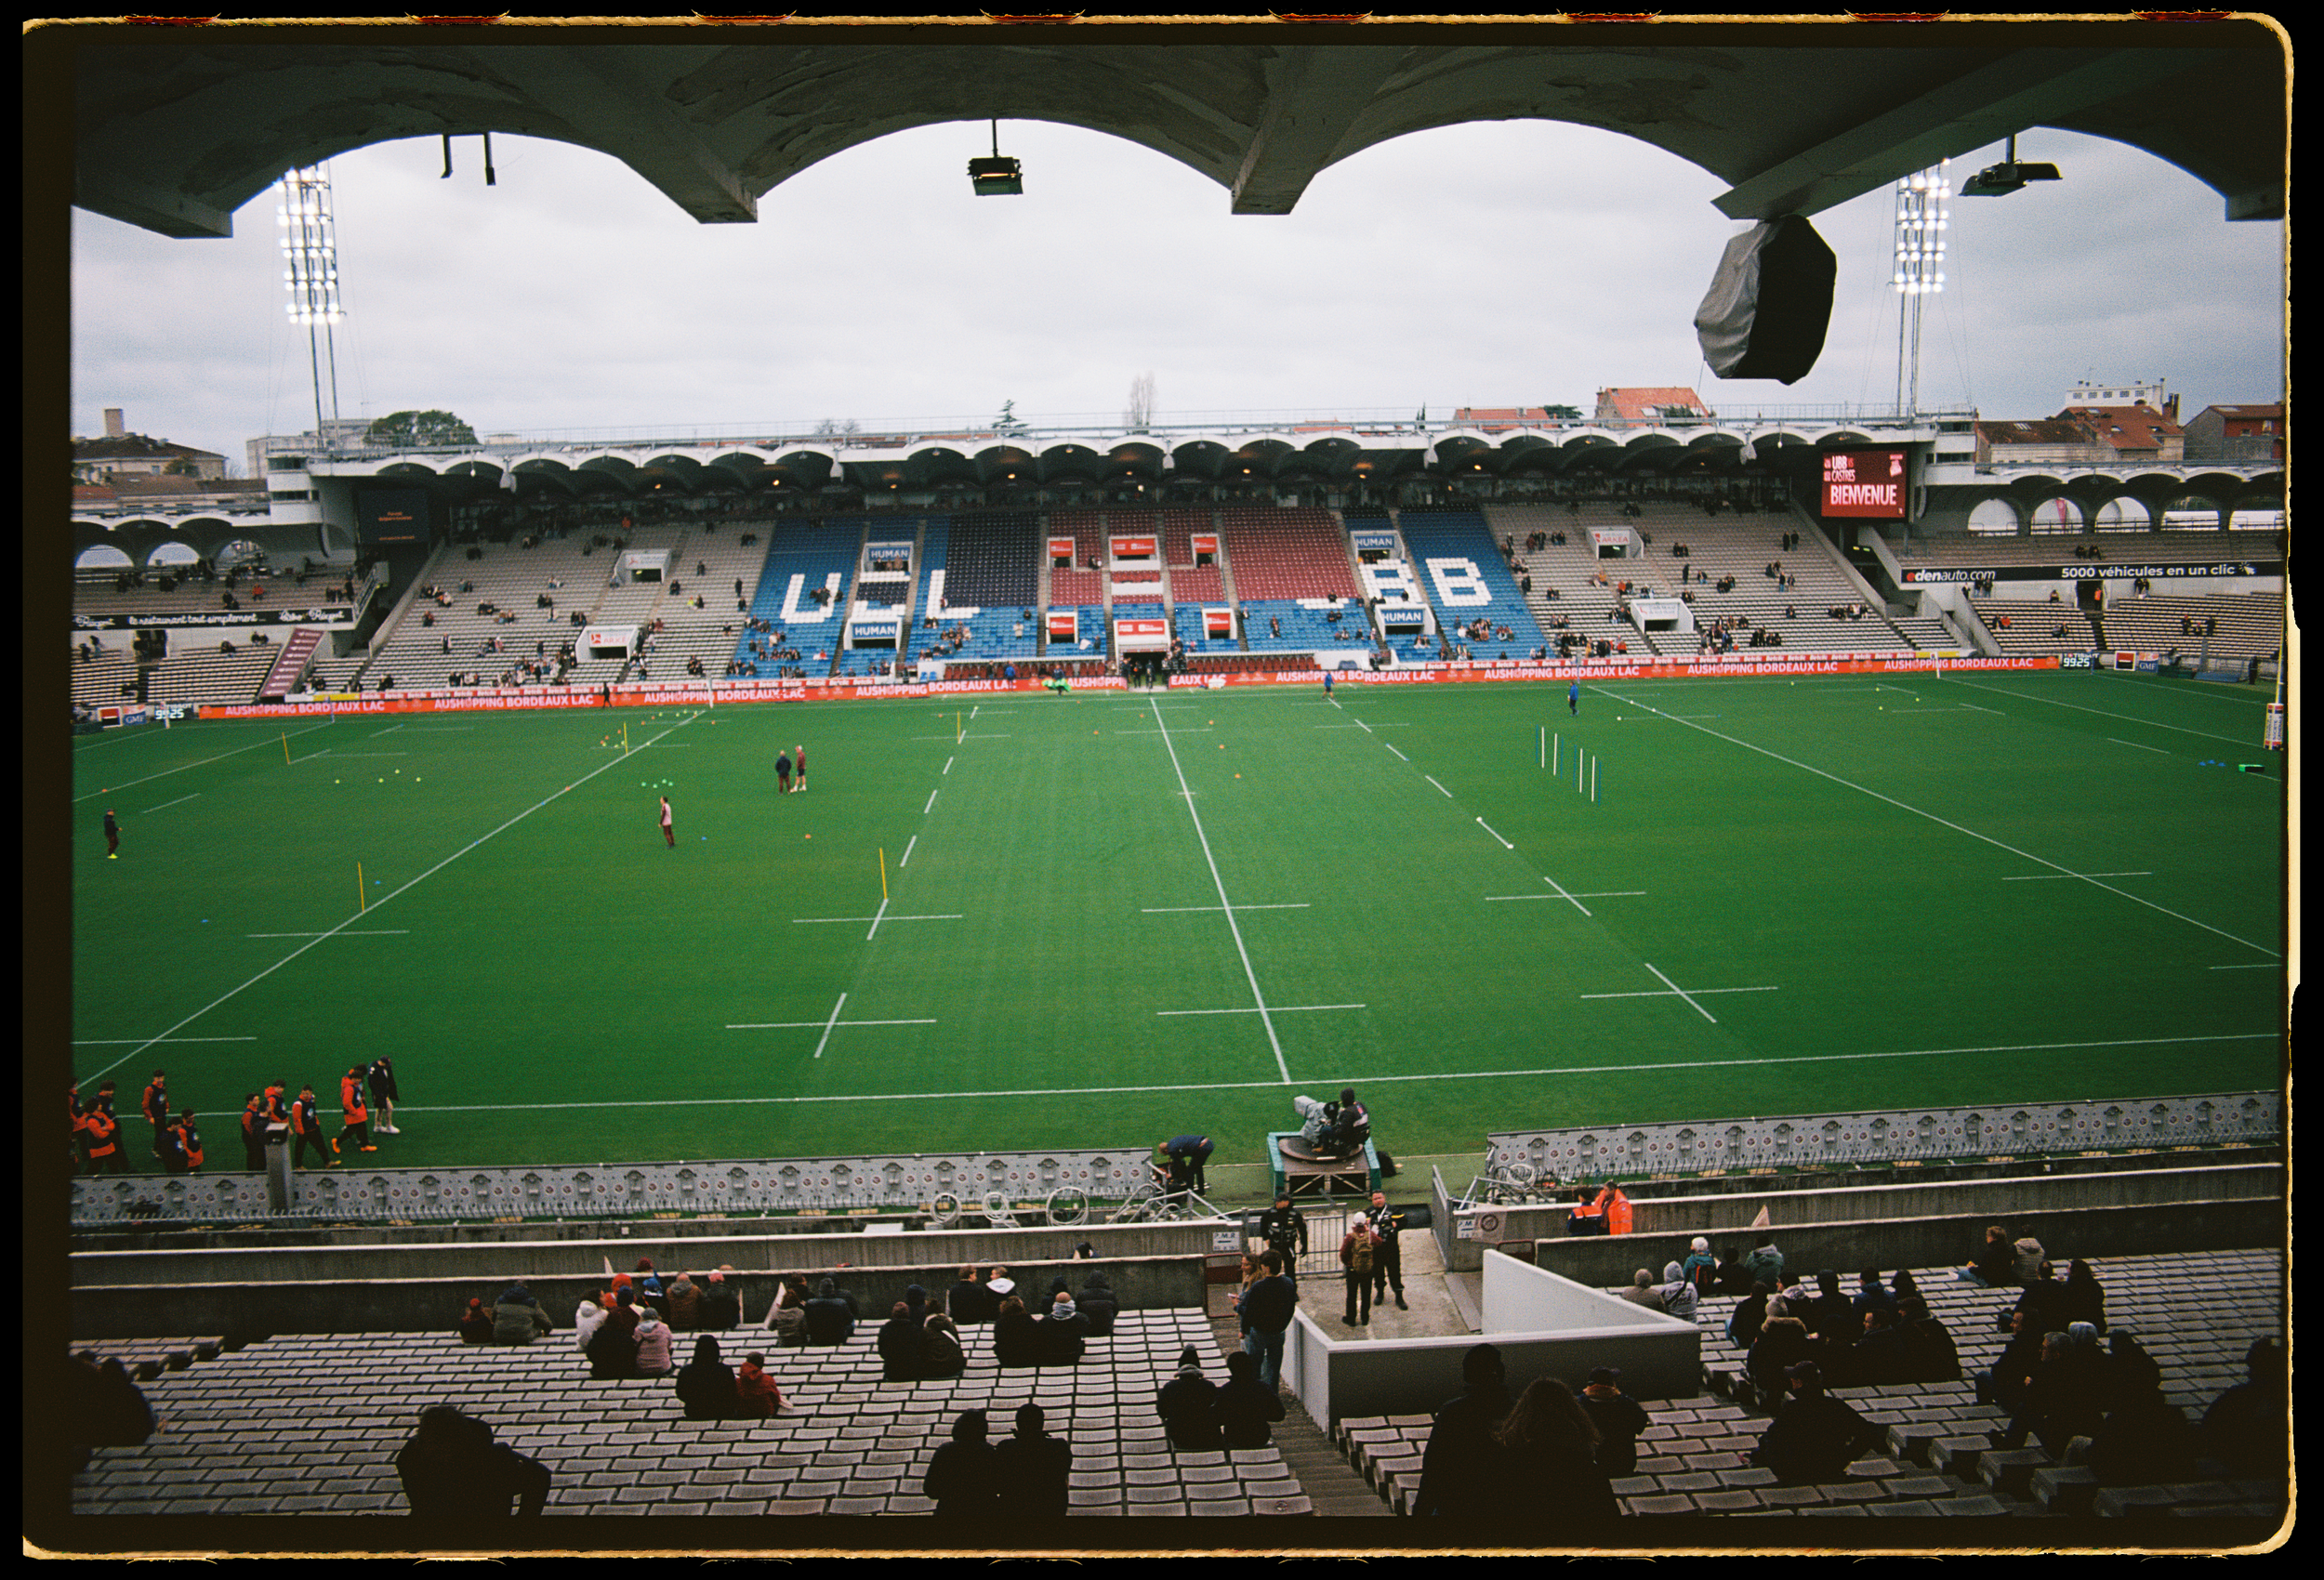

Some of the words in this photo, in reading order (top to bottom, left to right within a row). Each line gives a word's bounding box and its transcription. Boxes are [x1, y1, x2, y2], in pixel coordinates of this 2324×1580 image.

[1830, 484, 1897, 505] BIENVENUE
[1356, 538, 1393, 546] HUMAN
[871, 549, 908, 559] HUMAN
[1907, 569, 1996, 582] edenauto.com
[2061, 567, 2095, 578] 5000
[2098, 566, 2163, 577] véhicules
[2167, 568, 2185, 576] en
[2188, 567, 2206, 575] un
[2211, 564, 2236, 575] clic
[1382, 612, 1421, 622] HUMAN
[854, 625, 895, 636] HUMAN
[1687, 663, 1754, 675] AUSHOPPING
[1757, 662, 1814, 673] BORDEAUX
[1817, 661, 1838, 671] LAC
[1952, 657, 2009, 668] BORDEAUX
[2012, 657, 2034, 667] LAC
[2139, 662, 2157, 670] GMF
[1275, 670, 1345, 681] AUSHOPPNG
[1348, 670, 1410, 681] BORDEAUX
[1413, 670, 1435, 680] LAC
[1484, 666, 1552, 678] AUSHOPPING
[1555, 666, 1616, 678] BORDEAUX
[1618, 665, 1640, 676] LAC
[1171, 675, 1202, 685] EAUX
[856, 683, 927, 696] AUSHOPPING
[929, 679, 991, 692] BORDEAUX
[718, 689, 780, 701] BORDEAUX
[784, 688, 805, 699] LAC
[435, 696, 504, 709] AUSHOPPING
[507, 695, 568, 707] BORDEAUX
[572, 694, 593, 704] LAC
[225, 704, 297, 716] AUSHOPPING
[298, 702, 360, 713] BORDEAUX
[363, 701, 385, 711] LAC
